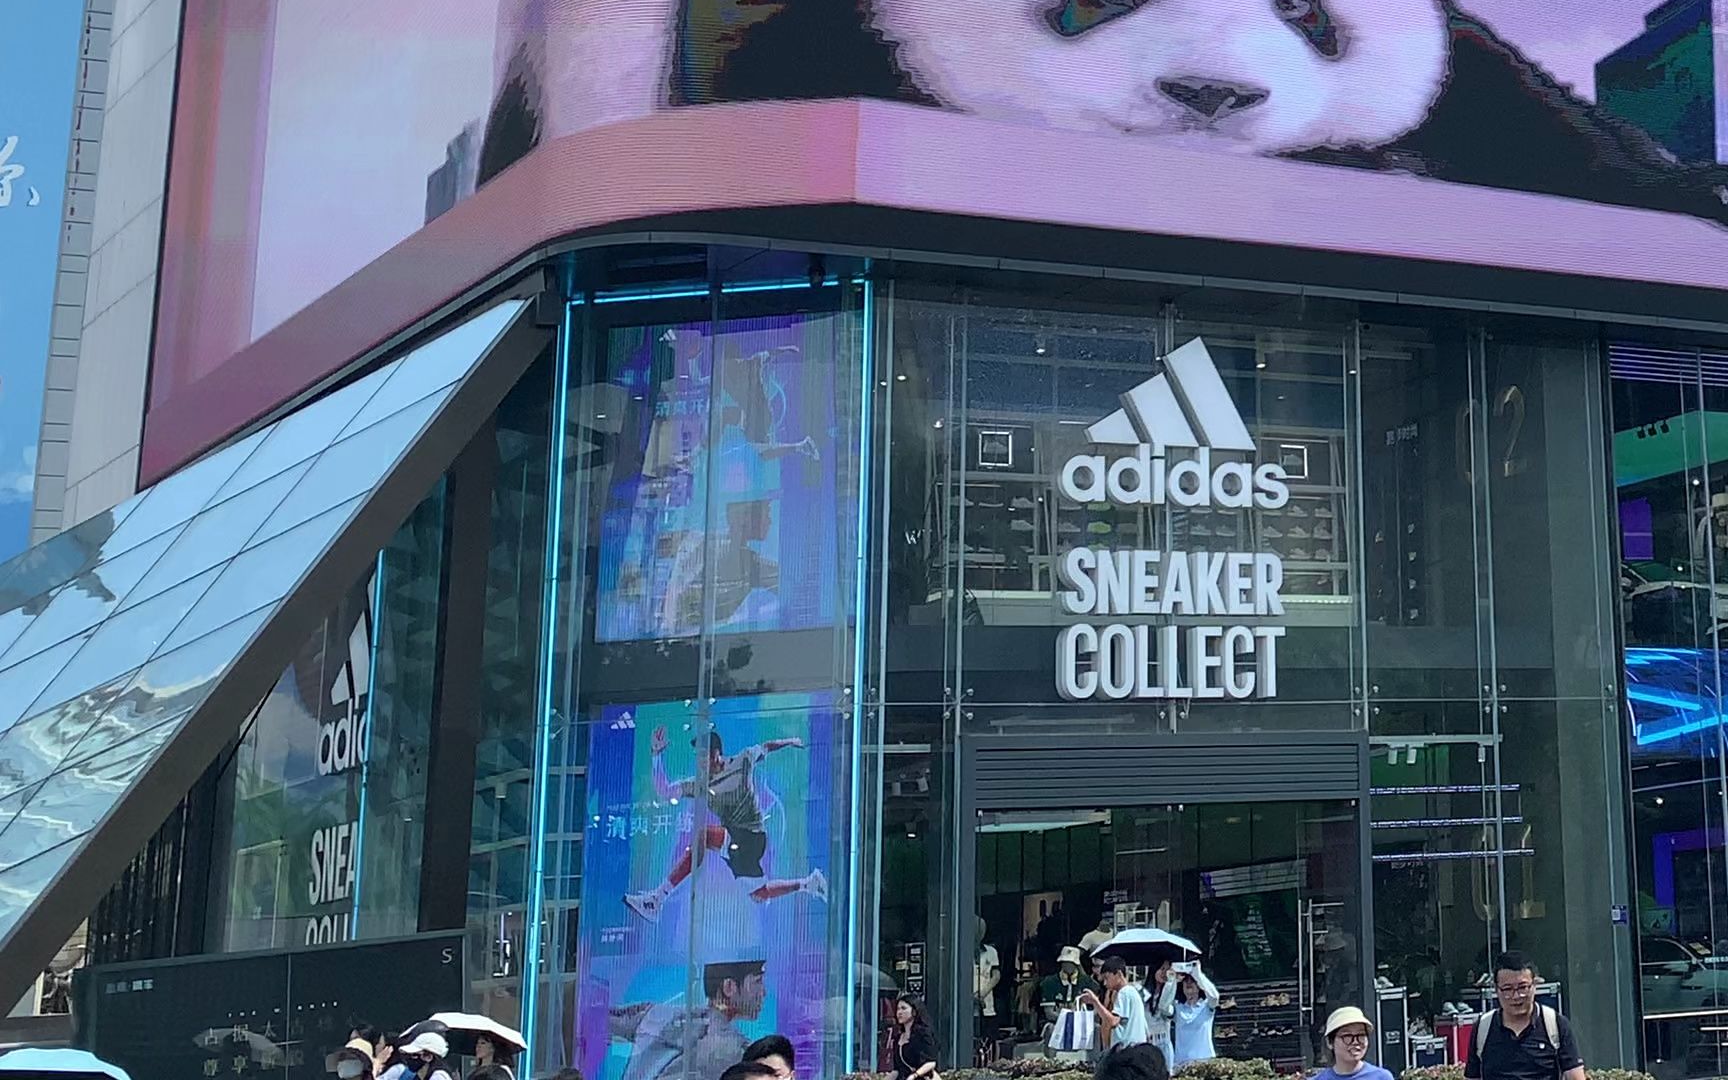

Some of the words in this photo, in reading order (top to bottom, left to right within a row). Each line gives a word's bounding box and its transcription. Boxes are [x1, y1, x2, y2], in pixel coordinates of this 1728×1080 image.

[1059, 443, 1289, 509] adidas
[1057, 547, 1284, 616] SNEAKER
[1056, 623, 1286, 701] COLLECT
